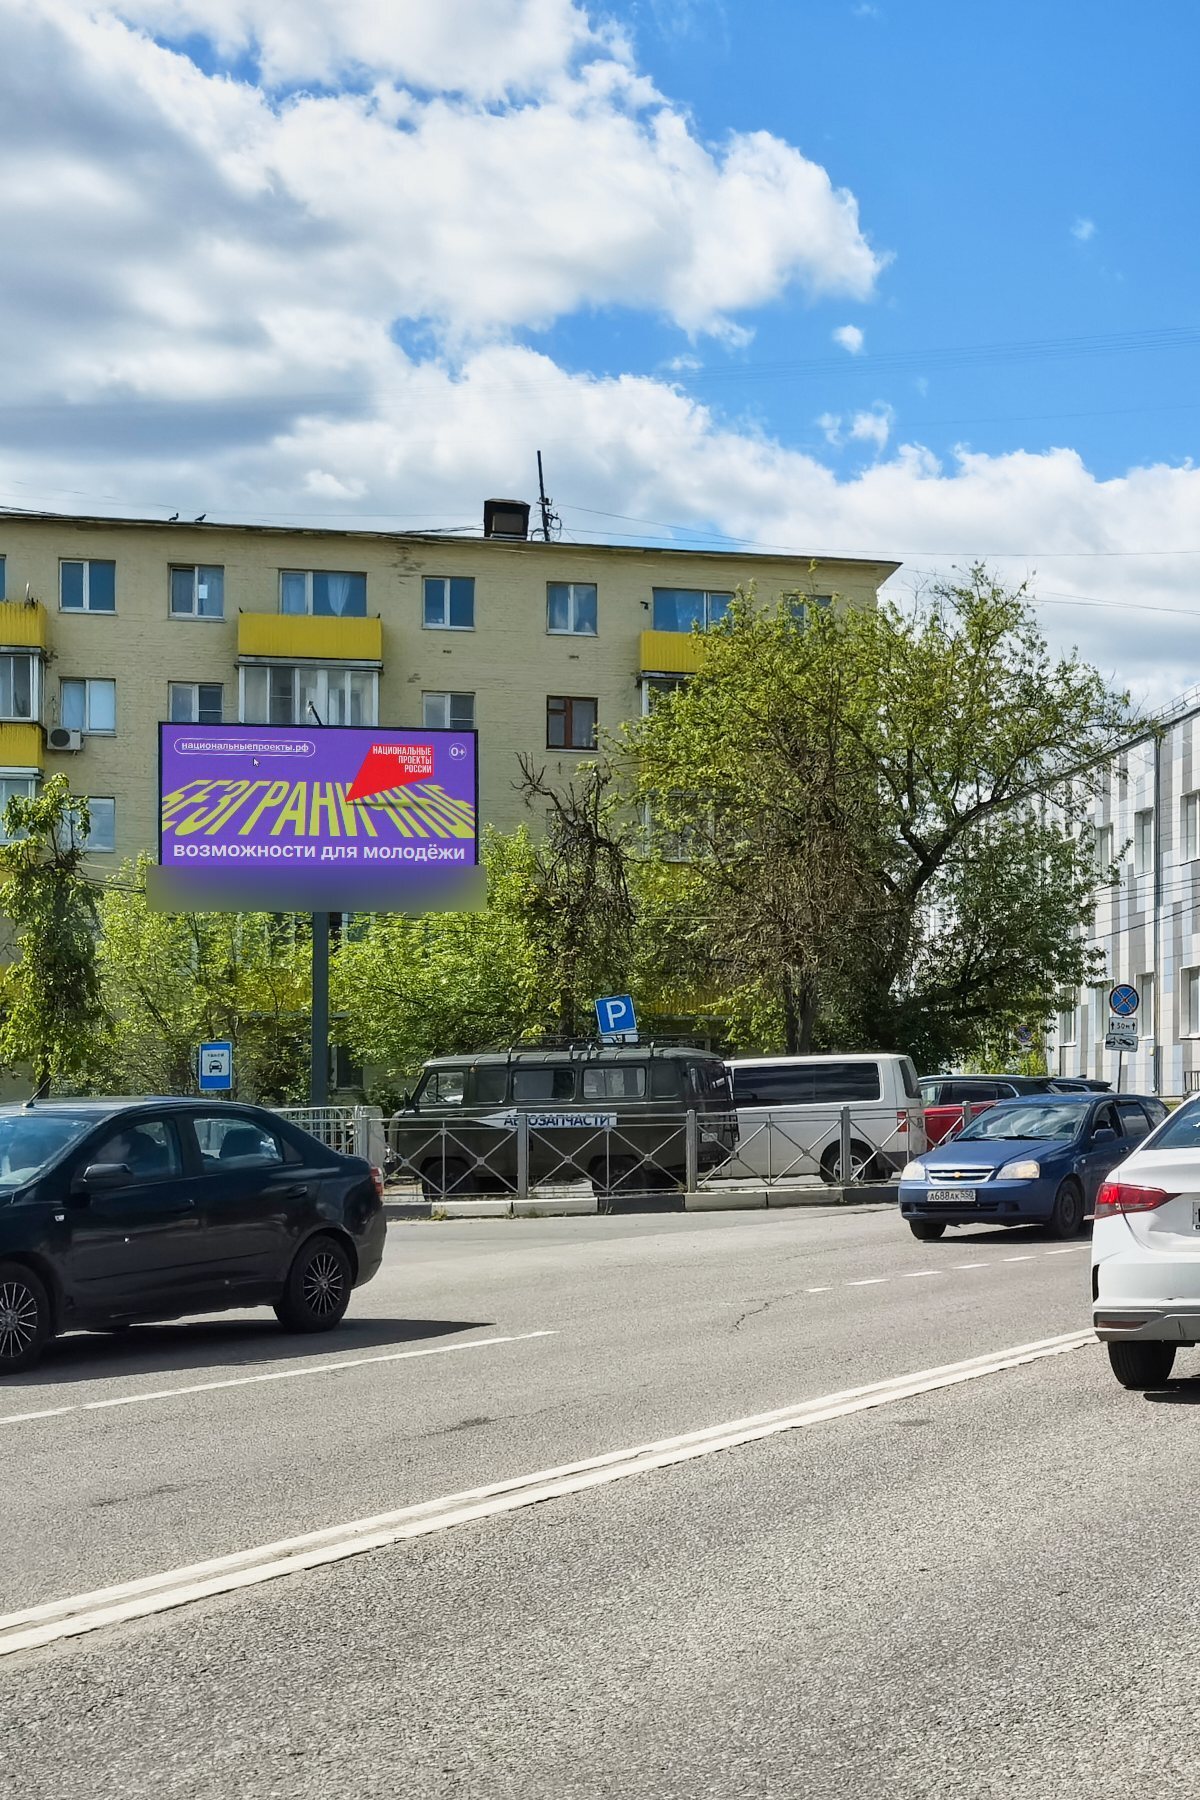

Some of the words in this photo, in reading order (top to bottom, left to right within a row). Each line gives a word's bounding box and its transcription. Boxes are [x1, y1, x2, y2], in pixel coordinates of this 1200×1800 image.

[181, 741, 309, 753] национальныепроекты.рф
[372, 745, 432, 756] НАЦИОНАЛЬНЫЕ
[398, 755, 432, 765] ПРОЕКТЫ
[404, 764, 432, 774] РОССИИ
[173, 844, 316, 858] возможности
[320, 846, 357, 861] для
[363, 843, 465, 862] молодёжи
[606, 1000, 626, 1028] P
